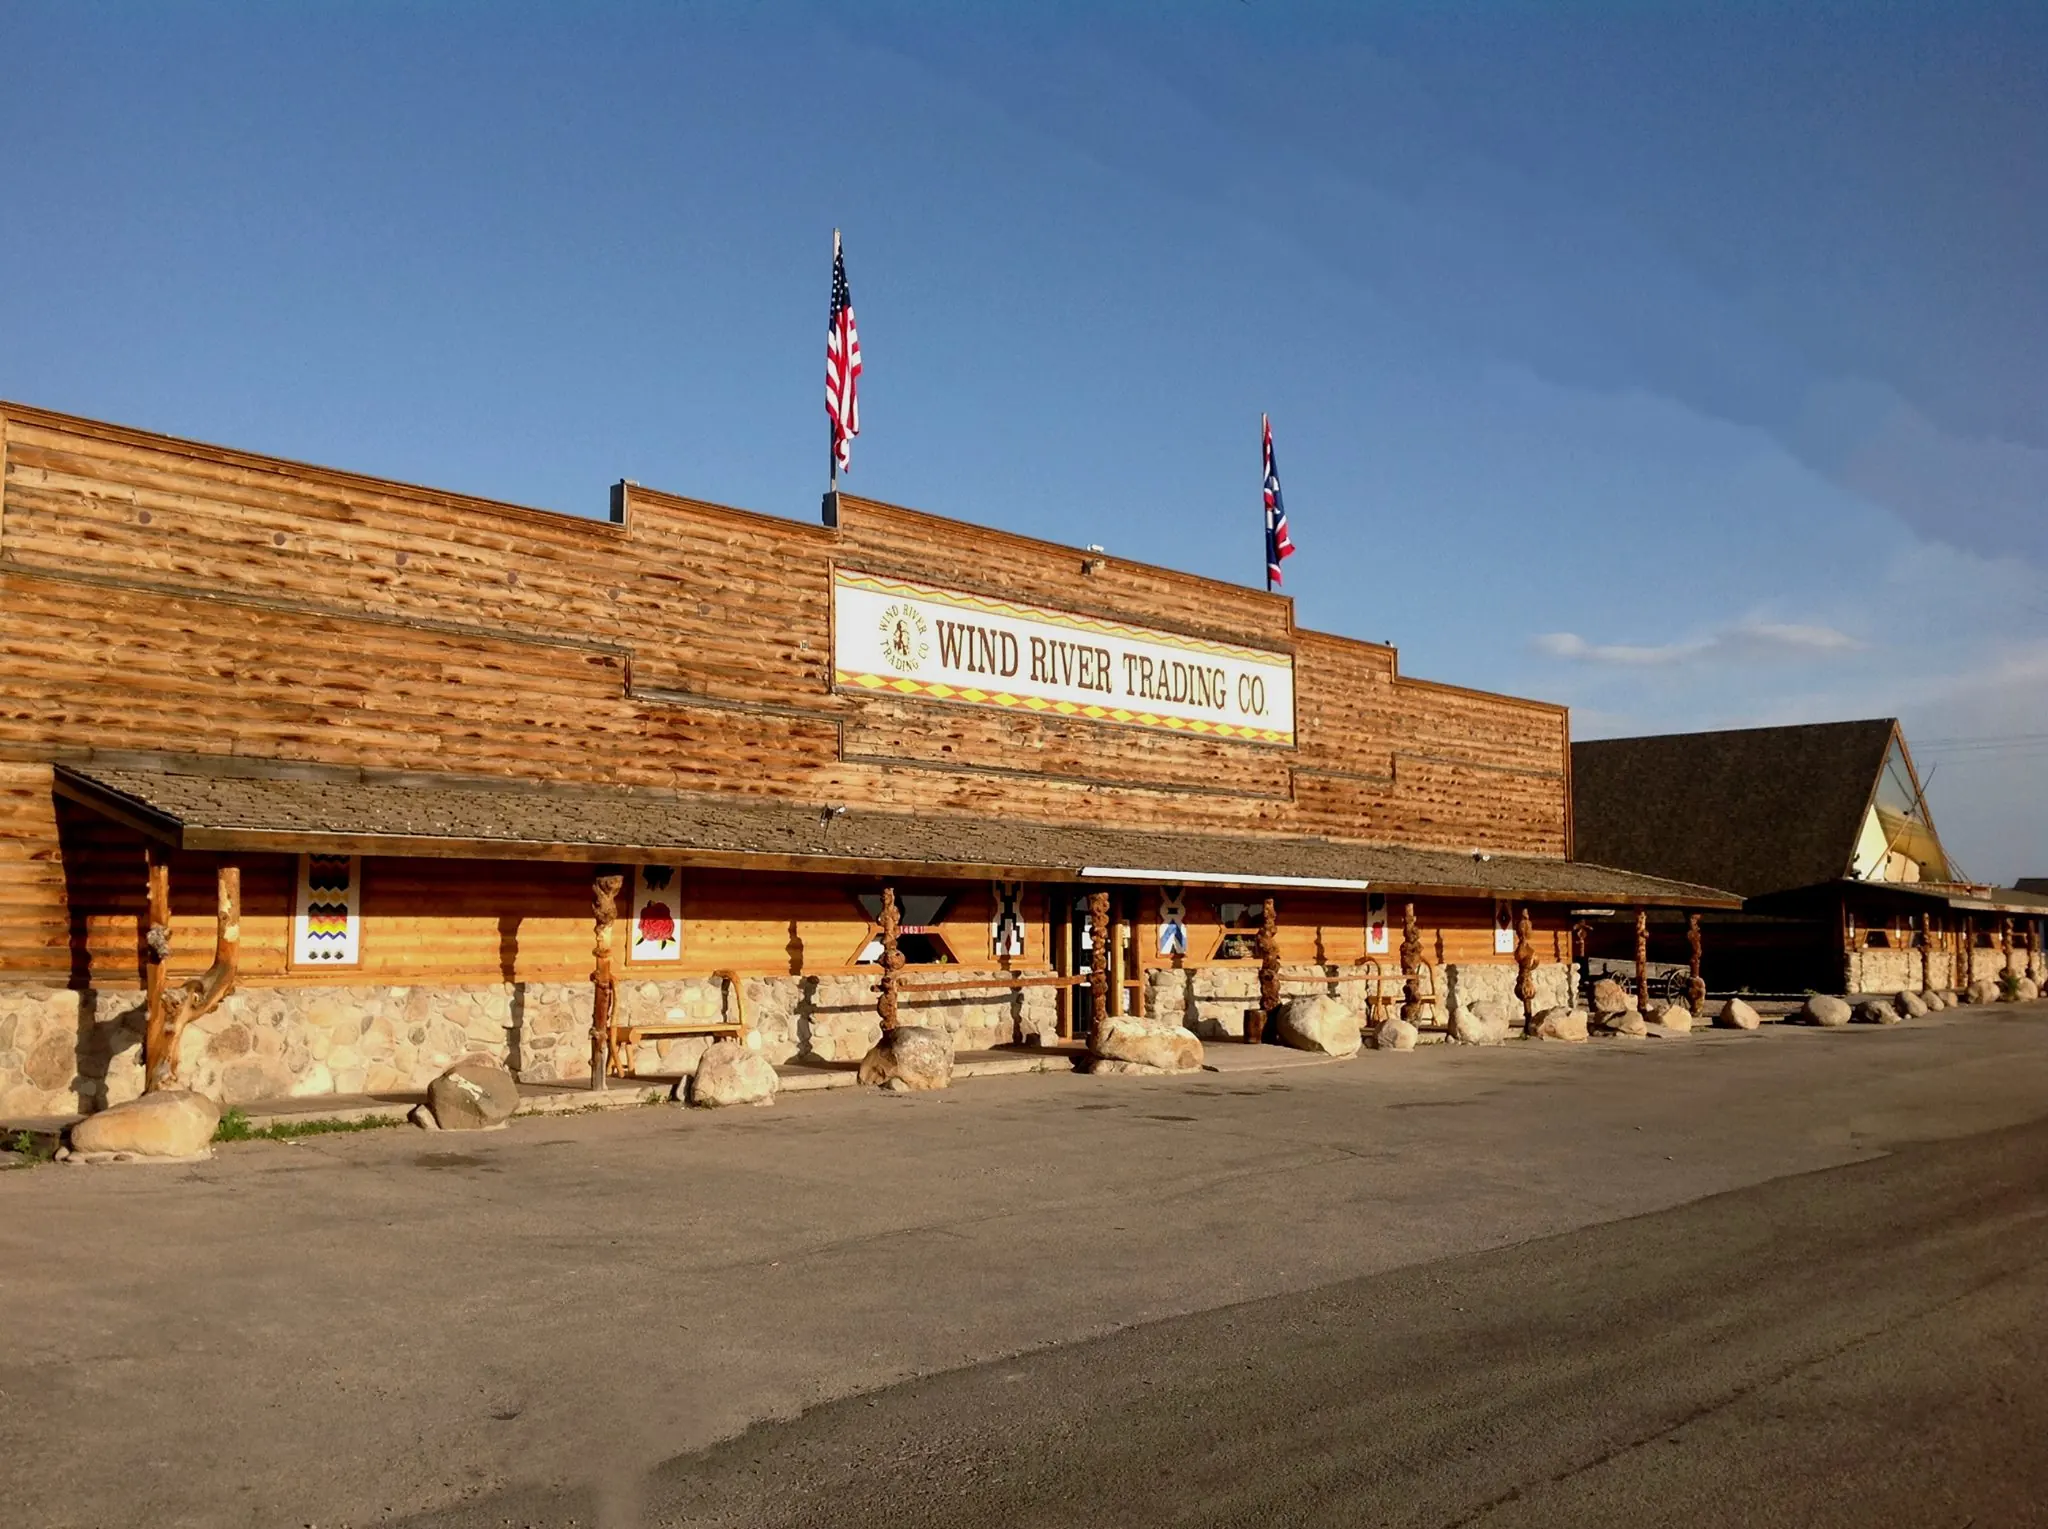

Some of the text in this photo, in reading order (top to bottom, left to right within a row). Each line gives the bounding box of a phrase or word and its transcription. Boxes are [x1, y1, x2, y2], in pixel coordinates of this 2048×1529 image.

[879, 604, 927, 636] WIND RIVER
[879, 639, 919, 673] TRADING
[935, 619, 1269, 716] WIND RIVER TRADING CO.
